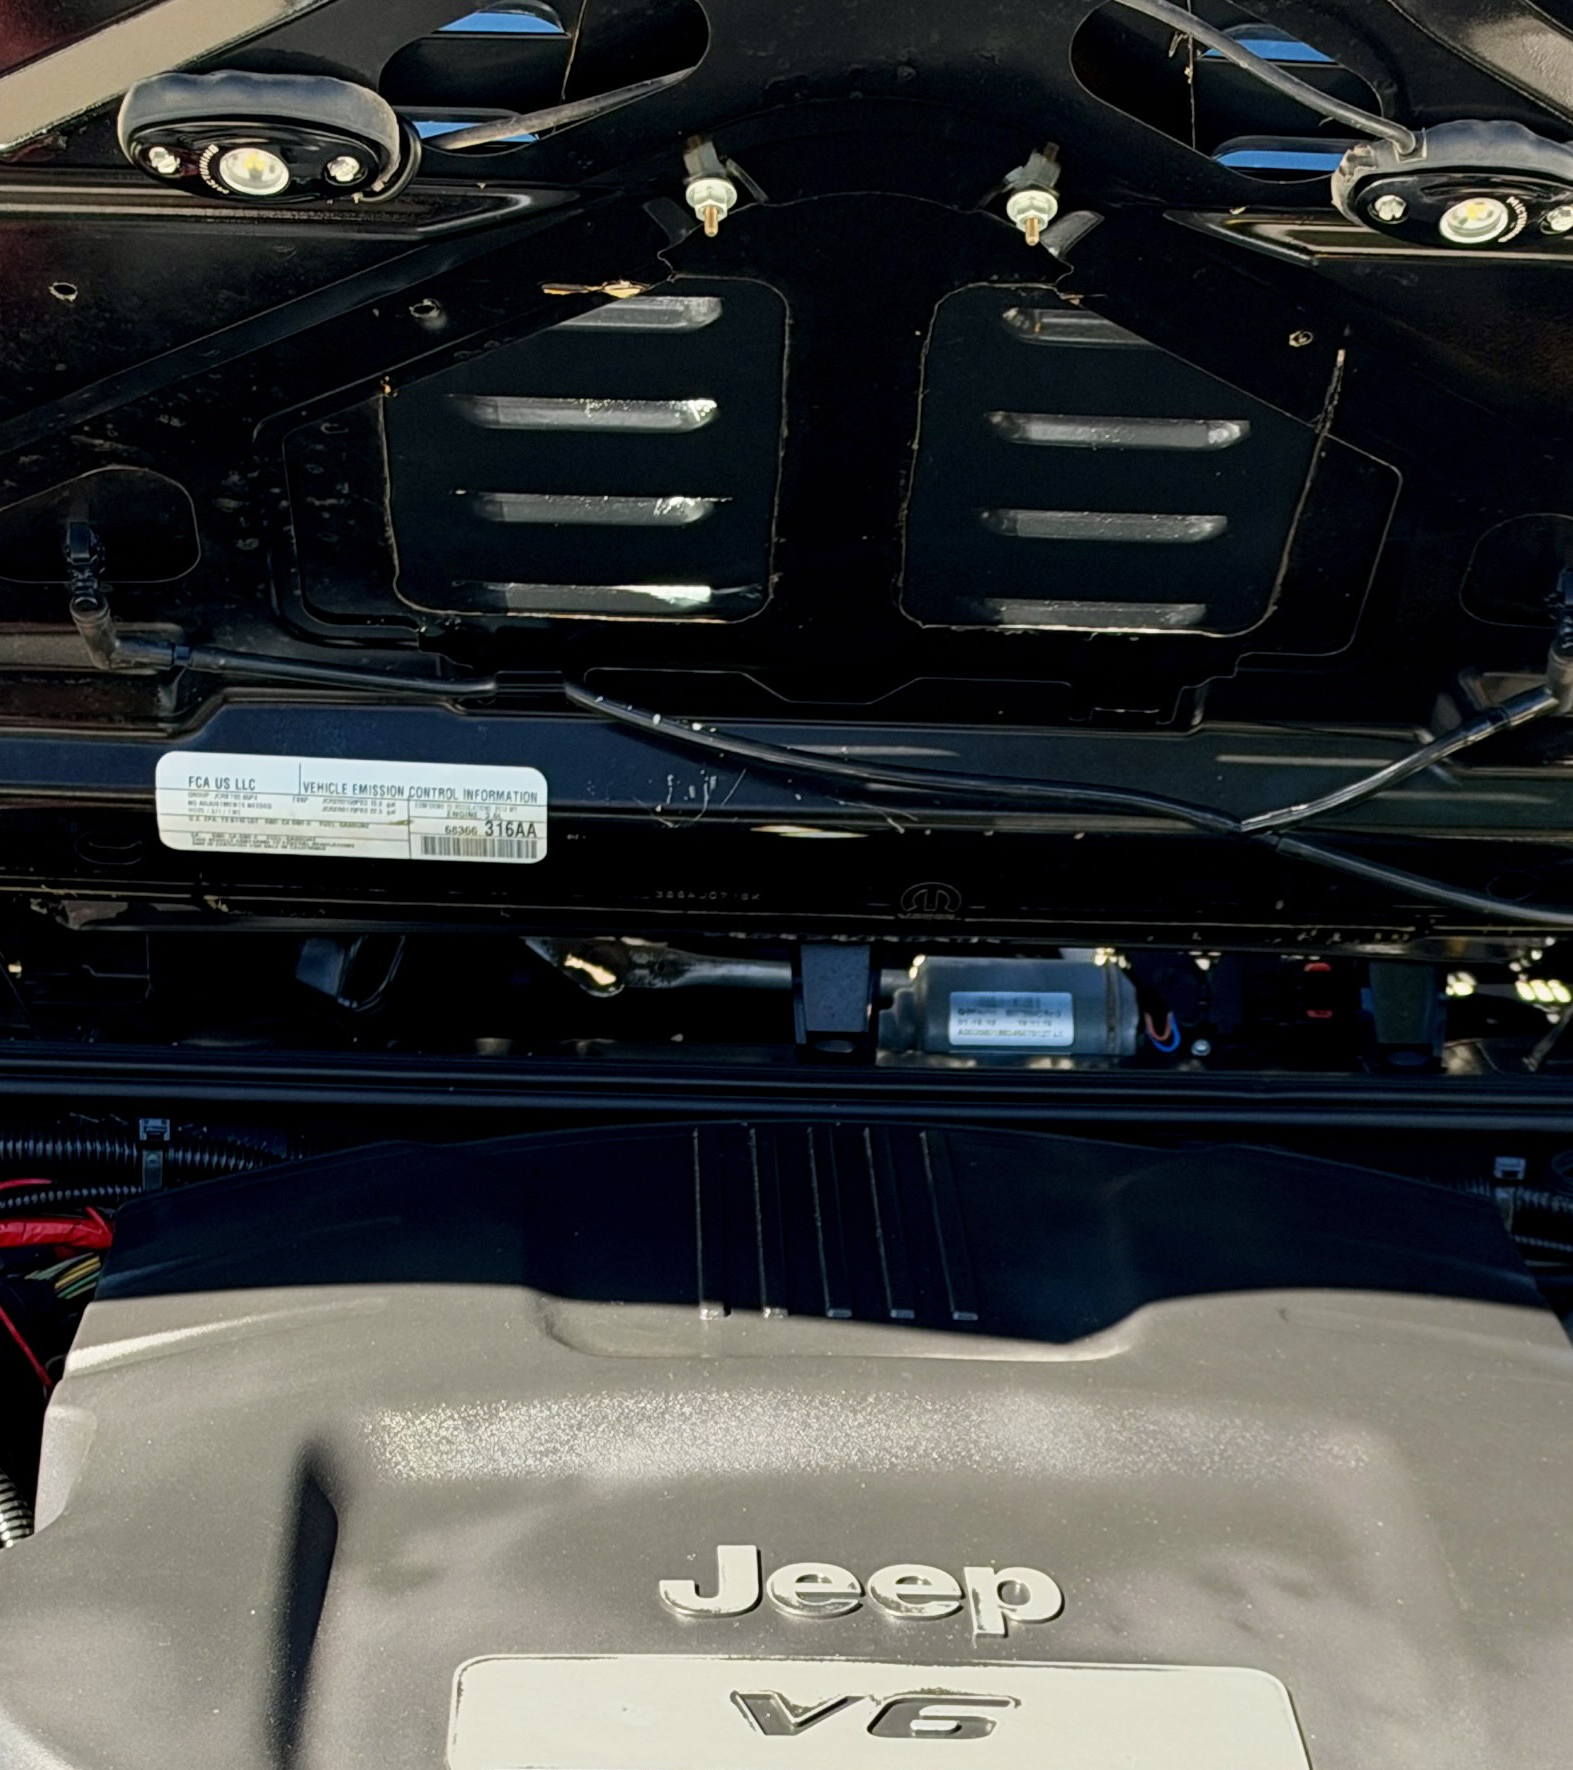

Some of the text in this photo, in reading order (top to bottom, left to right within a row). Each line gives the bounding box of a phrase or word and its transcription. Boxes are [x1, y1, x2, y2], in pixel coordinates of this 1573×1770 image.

[188, 775, 256, 791] FCA US LLC
[303, 782, 538, 803] VEHICLE EMISSION CONTROL INFORMATION
[484, 820, 537, 837] 316AA
[659, 1544, 1064, 1638] Jeep
[729, 1688, 1022, 1740] V6
